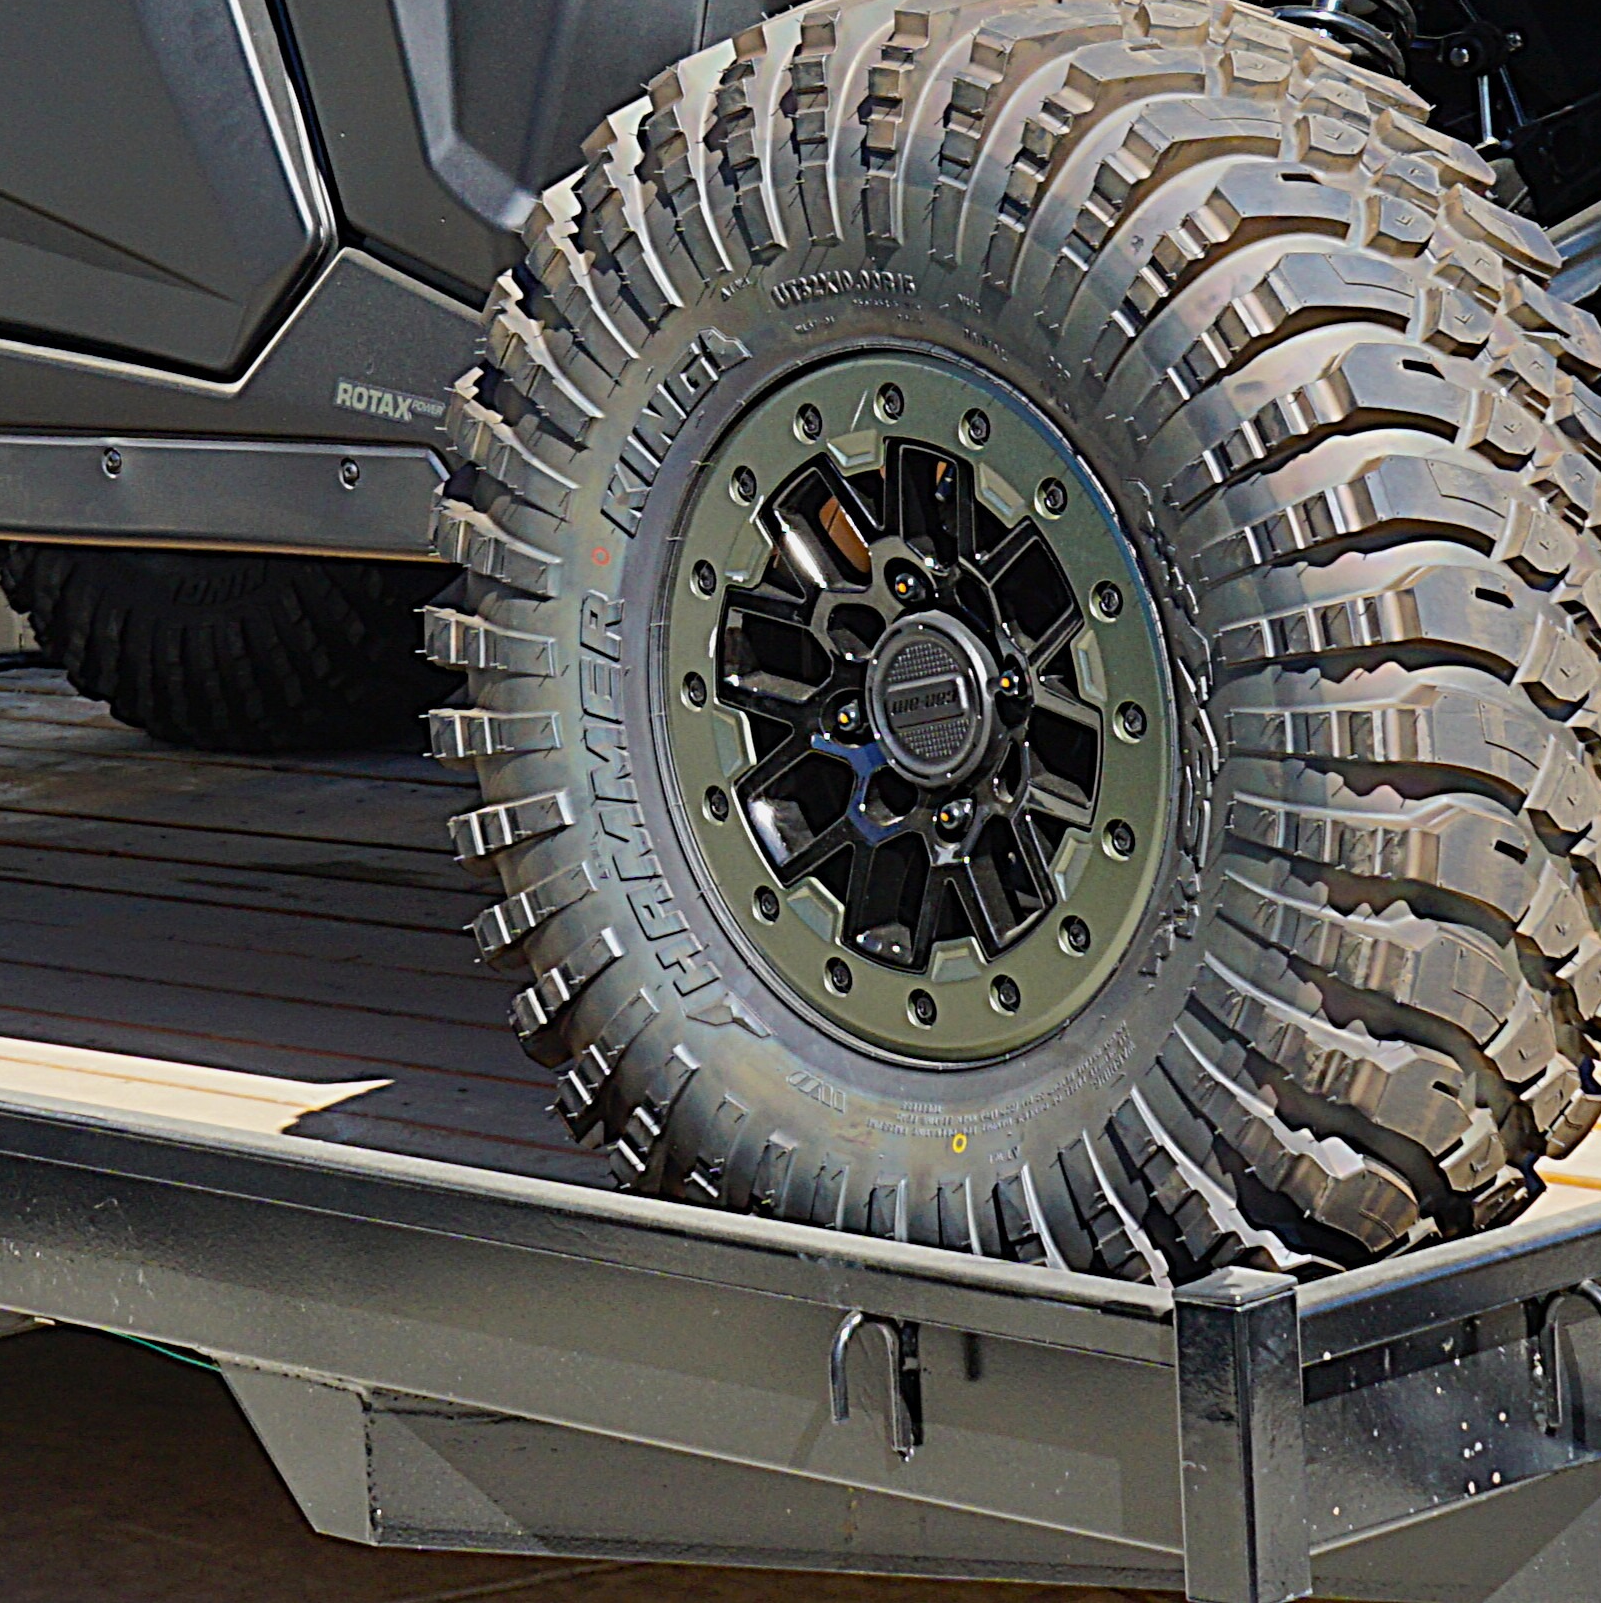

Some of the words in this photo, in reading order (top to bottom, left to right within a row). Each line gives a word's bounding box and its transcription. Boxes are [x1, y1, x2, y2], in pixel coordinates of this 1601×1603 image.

[335, 381, 413, 422] ROTAX
[411, 399, 444, 417] POWER
[598, 353, 728, 541] KING
[579, 588, 723, 998] HAMMER
